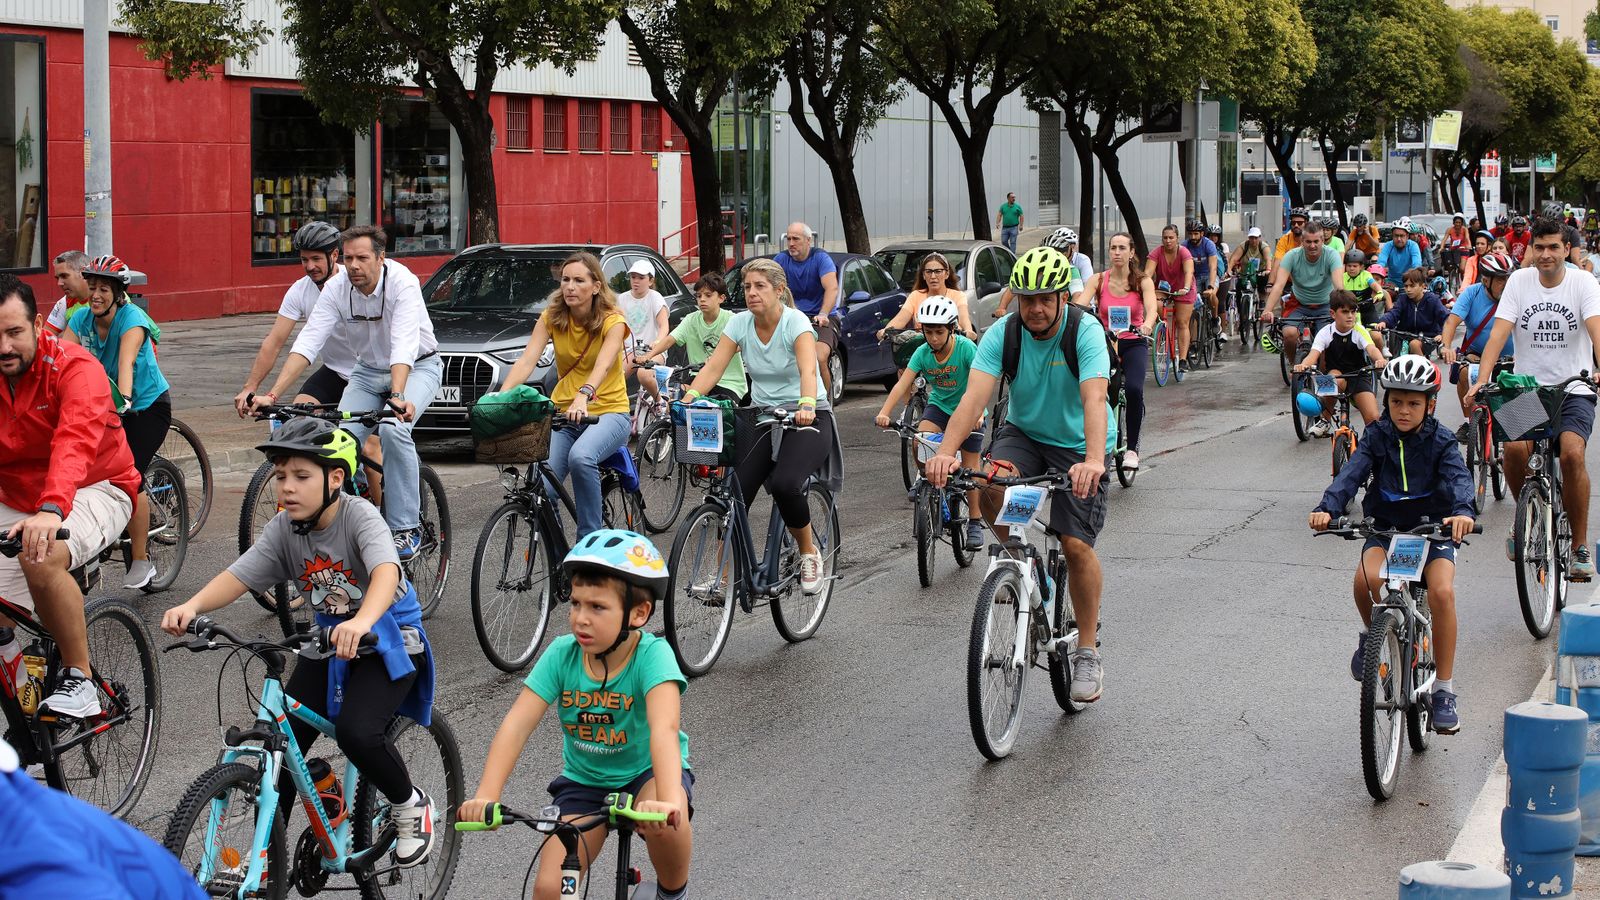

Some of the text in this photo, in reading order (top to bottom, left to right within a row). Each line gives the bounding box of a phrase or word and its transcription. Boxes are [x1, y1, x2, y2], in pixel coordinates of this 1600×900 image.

[1521, 302, 1578, 331] ABERCROMBIE
[1538, 320, 1560, 330] AND
[1533, 332, 1565, 342] FITCH
[562, 690, 634, 711] SIDNEY
[581, 712, 611, 724] 1973
[564, 723, 627, 746] TEAM
[295, 752, 335, 835] ROCKRIDER
